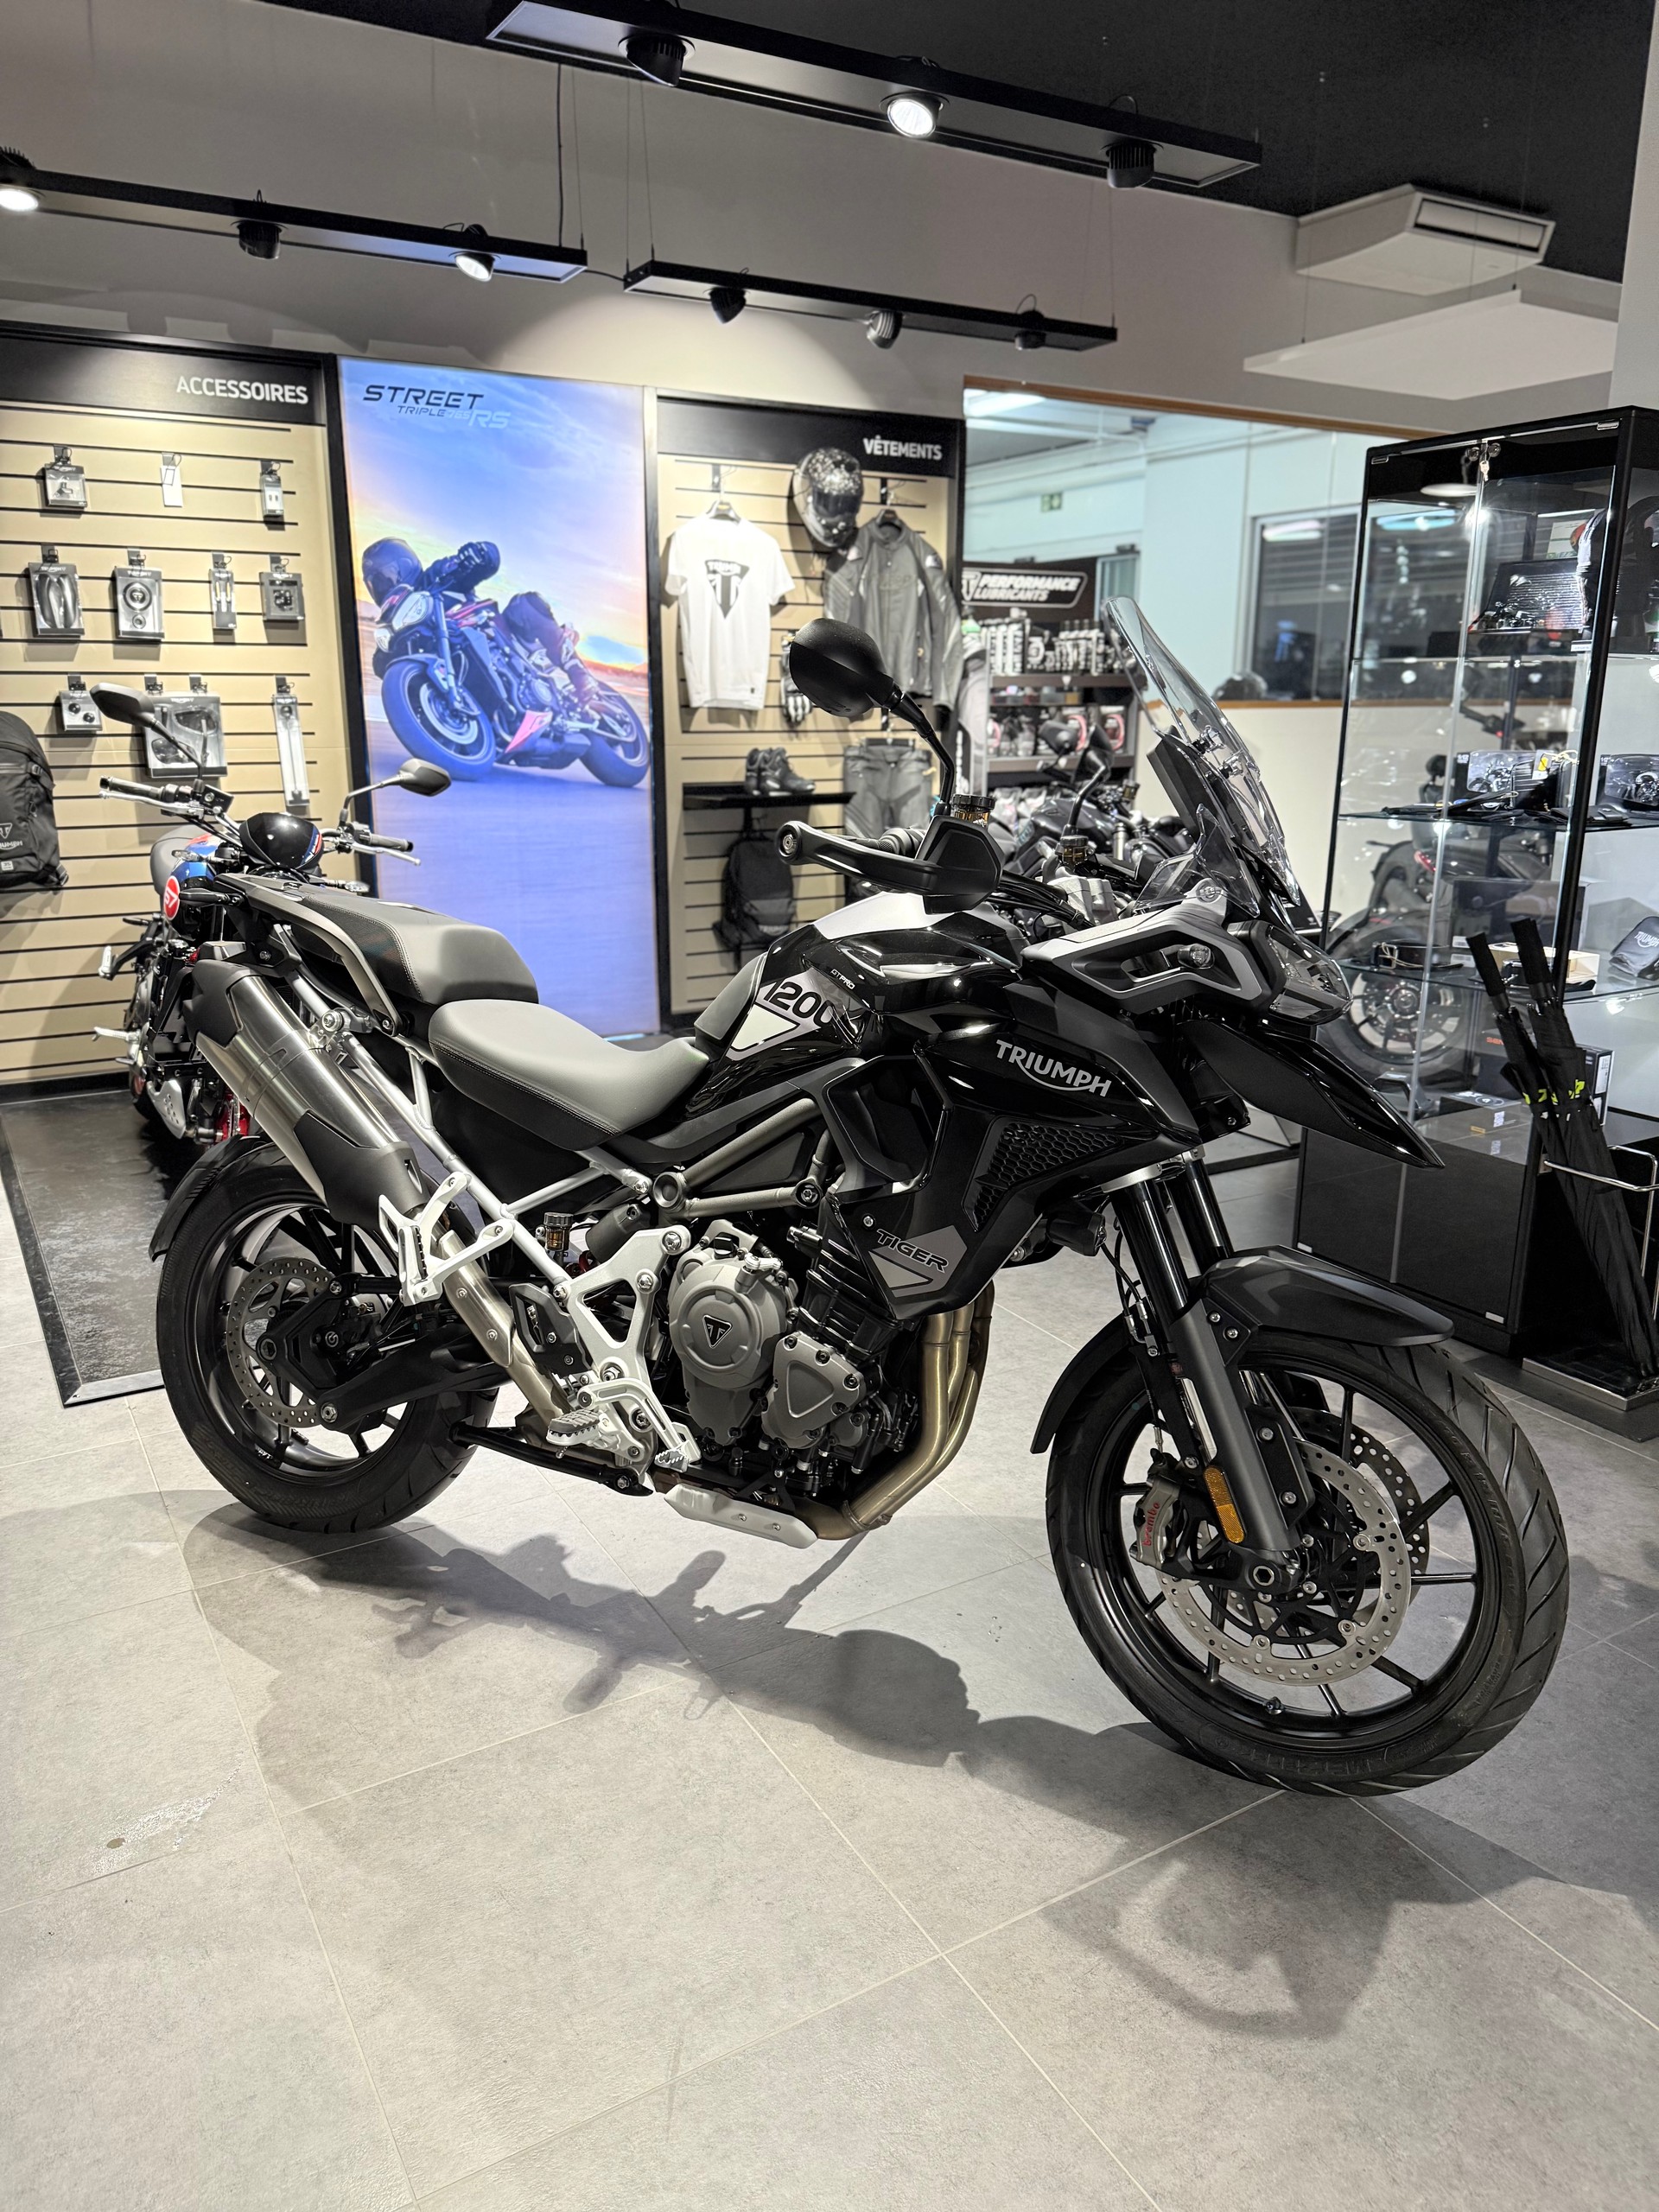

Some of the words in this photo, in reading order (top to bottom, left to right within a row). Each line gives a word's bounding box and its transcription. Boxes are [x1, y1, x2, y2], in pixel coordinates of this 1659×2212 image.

[176, 375, 308, 404] ACCESSOIRES
[363, 385, 484, 410] STREET
[397, 405, 446, 417] TRIPLE
[467, 410, 512, 429] RS
[862, 435, 943, 461] VÊTEMENTS
[973, 588, 1050, 602] LUBRICANTS
[978, 574, 1081, 592] PERFORMANCE
[763, 982, 835, 1027] 1200
[995, 1039, 1112, 1097] TRIUMPH
[876, 1229, 950, 1274] TIGER
[1142, 1503, 1160, 1547] brembo
